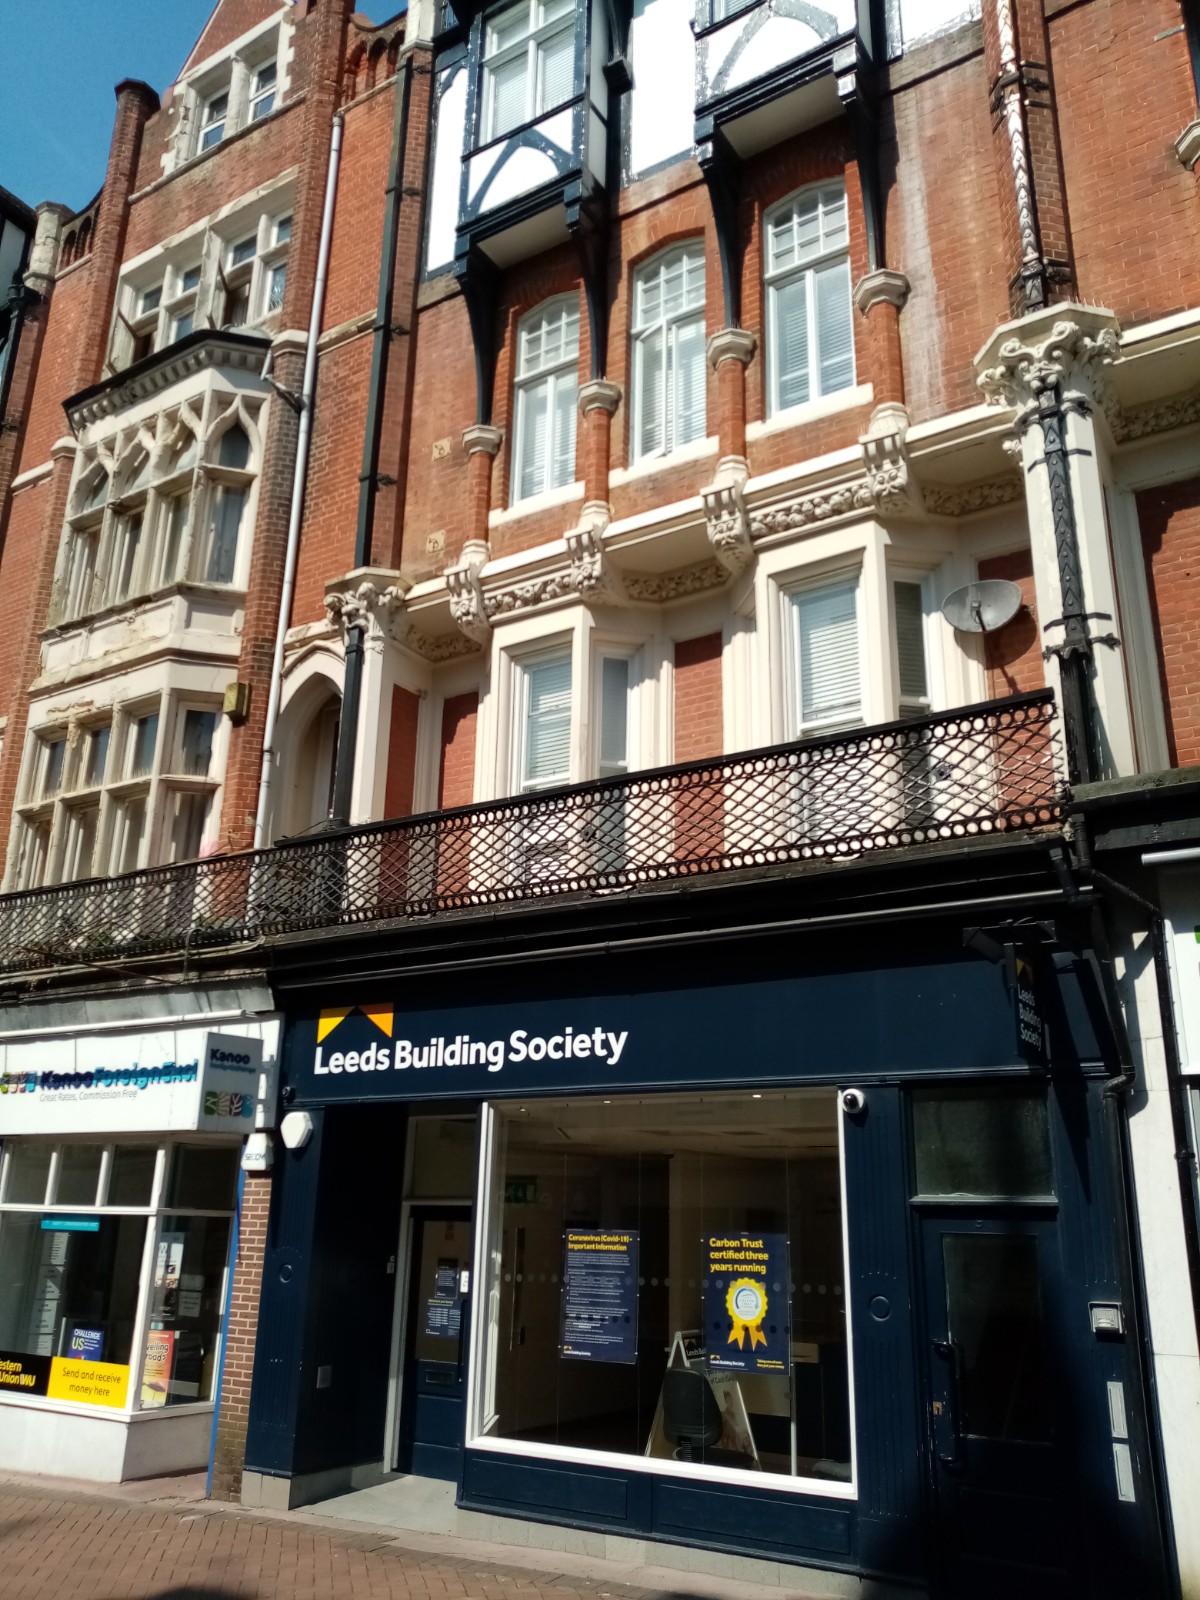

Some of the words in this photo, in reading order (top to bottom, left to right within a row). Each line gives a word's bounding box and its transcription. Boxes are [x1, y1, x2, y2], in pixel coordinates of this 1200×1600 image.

[1017, 983, 1036, 1007] Leeds
[1018, 1002, 1042, 1032] Building
[1020, 1022, 1042, 1052] Society
[210, 1049, 251, 1065] Kanoo
[313, 1041, 390, 1076] Leeds
[393, 1034, 505, 1073] Building
[508, 1026, 629, 1065] Society
[40, 1091, 58, 1103] Great
[58, 1091, 78, 1102] Rates,
[79, 1090, 122, 1101] Commission
[122, 1089, 138, 1100] Free
[568, 1233, 601, 1243] Coronavirus
[709, 1237, 741, 1248] Carbon
[741, 1238, 764, 1249] Trust
[567, 1242, 596, 1252] Important
[595, 1243, 628, 1252] Information
[709, 1250, 745, 1260] certified
[746, 1251, 769, 1261] three
[709, 1263, 733, 1274] years
[733, 1263, 767, 1275] running
[74, 1328, 102, 1341] CHALLENGE
[71, 1336, 85, 1351] US
[146, 1341, 169, 1354] velling
[145, 1353, 167, 1362] road?
[0, 1359, 23, 1372] estern
[0, 1371, 20, 1385] Union
[62, 1366, 80, 1379] Send
[80, 1370, 95, 1381] and
[95, 1373, 122, 1384] receive
[69, 1383, 93, 1396] money
[94, 1385, 111, 1397] here
